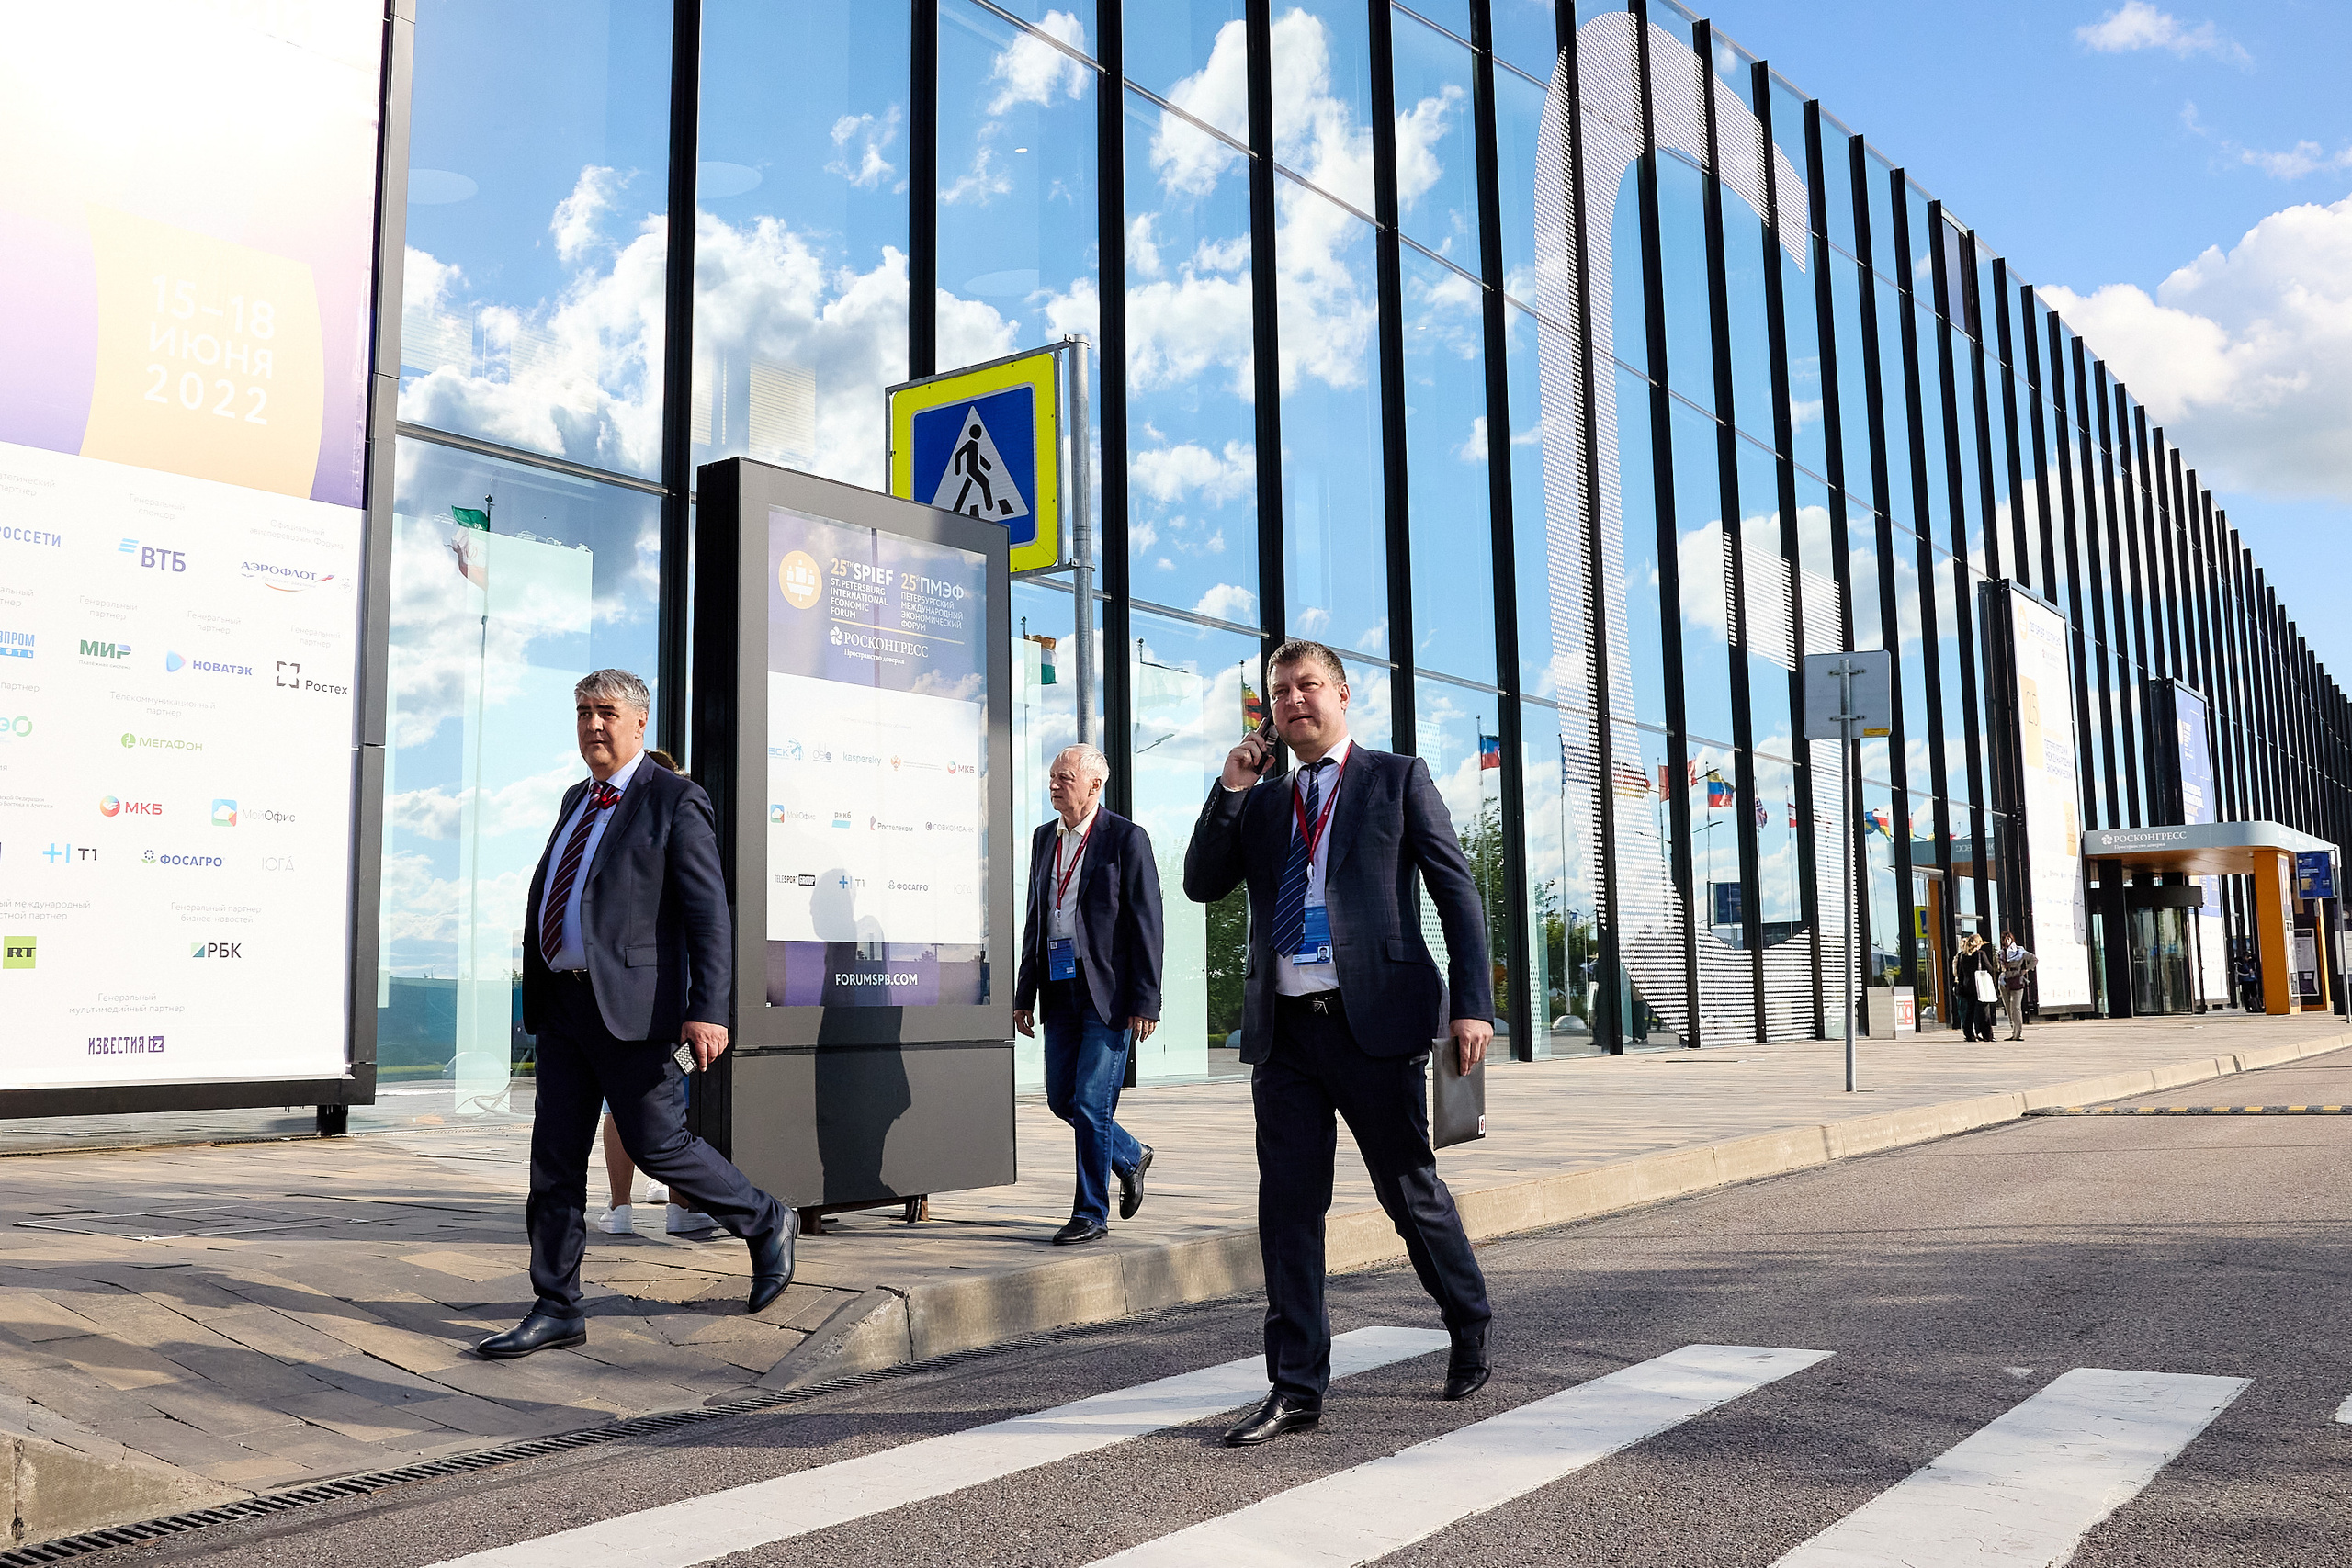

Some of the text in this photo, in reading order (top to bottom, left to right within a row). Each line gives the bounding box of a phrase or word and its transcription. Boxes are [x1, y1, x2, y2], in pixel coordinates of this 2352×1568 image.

[149, 321, 274, 380] ИЮНЯ
[144, 364, 268, 426] 2022
[129, 493, 186, 512] Генеральный
[138, 507, 175, 521] спонсор
[270, 519, 325, 536] Официальный
[313, 536, 344, 551] Форума
[141, 546, 187, 573] ВТБ
[241, 561, 318, 581] АЭРОФЛОТ
[854, 563, 894, 586] SPIEF
[842, 579, 886, 596] PETERSBURG
[921, 576, 964, 601] ПМЭФ
[79, 595, 138, 612] Генеральный
[831, 587, 888, 606] INTERNATIONAL
[831, 596, 869, 612] ECONOMIC
[901, 592, 954, 609] ПЕТЕРБУРГСКИЙ
[89, 609, 127, 622] партнер
[187, 610, 241, 626] Генеральный
[831, 607, 856, 619] FORUM
[901, 601, 963, 620] МЕЖДУНАРОДНЫЙ
[901, 610, 962, 629] ЭКОНОМИЧЕСКИЙ
[901, 619, 926, 631] ФОРУМ
[197, 622, 231, 635] партнер
[290, 625, 341, 639] Генеральный
[80, 639, 132, 660] МИР
[299, 636, 331, 649] партнер
[843, 631, 929, 658] РОСКОНГРЕСС
[844, 648, 904, 665] Пространство доверия
[192, 660, 253, 677] НОВАТЭК
[1, 682, 40, 694] партнер
[305, 680, 348, 695] Ростех
[110, 691, 216, 711] Телекоммуникационный
[146, 705, 182, 718] партнер
[842, 751, 882, 766] kaspersky
[958, 764, 975, 775] МКБ
[125, 801, 163, 816] МКБ
[242, 808, 296, 823] МойОфис
[877, 822, 913, 832] Ростелеком
[933, 823, 974, 833] СОВКОМБАНК
[2114, 830, 2187, 843] РОСКОНГРЕСС
[775, 874, 816, 886] TELESPORT GROUP
[897, 883, 929, 892] ФОСАГРО
[15, 899, 91, 910] международный
[171, 901, 261, 914] Генеральный партнер
[28, 911, 67, 921] партнер
[180, 913, 254, 924] бизнес-новостей
[7, 947, 36, 957] RT
[207, 942, 242, 959] РБК
[835, 973, 919, 987] FORUMSPB.COM
[98, 992, 157, 1003] Генеральный
[69, 1003, 185, 1015] мультимедийный партнер
[88, 1036, 144, 1055] ИЗВЕСТИЯ
